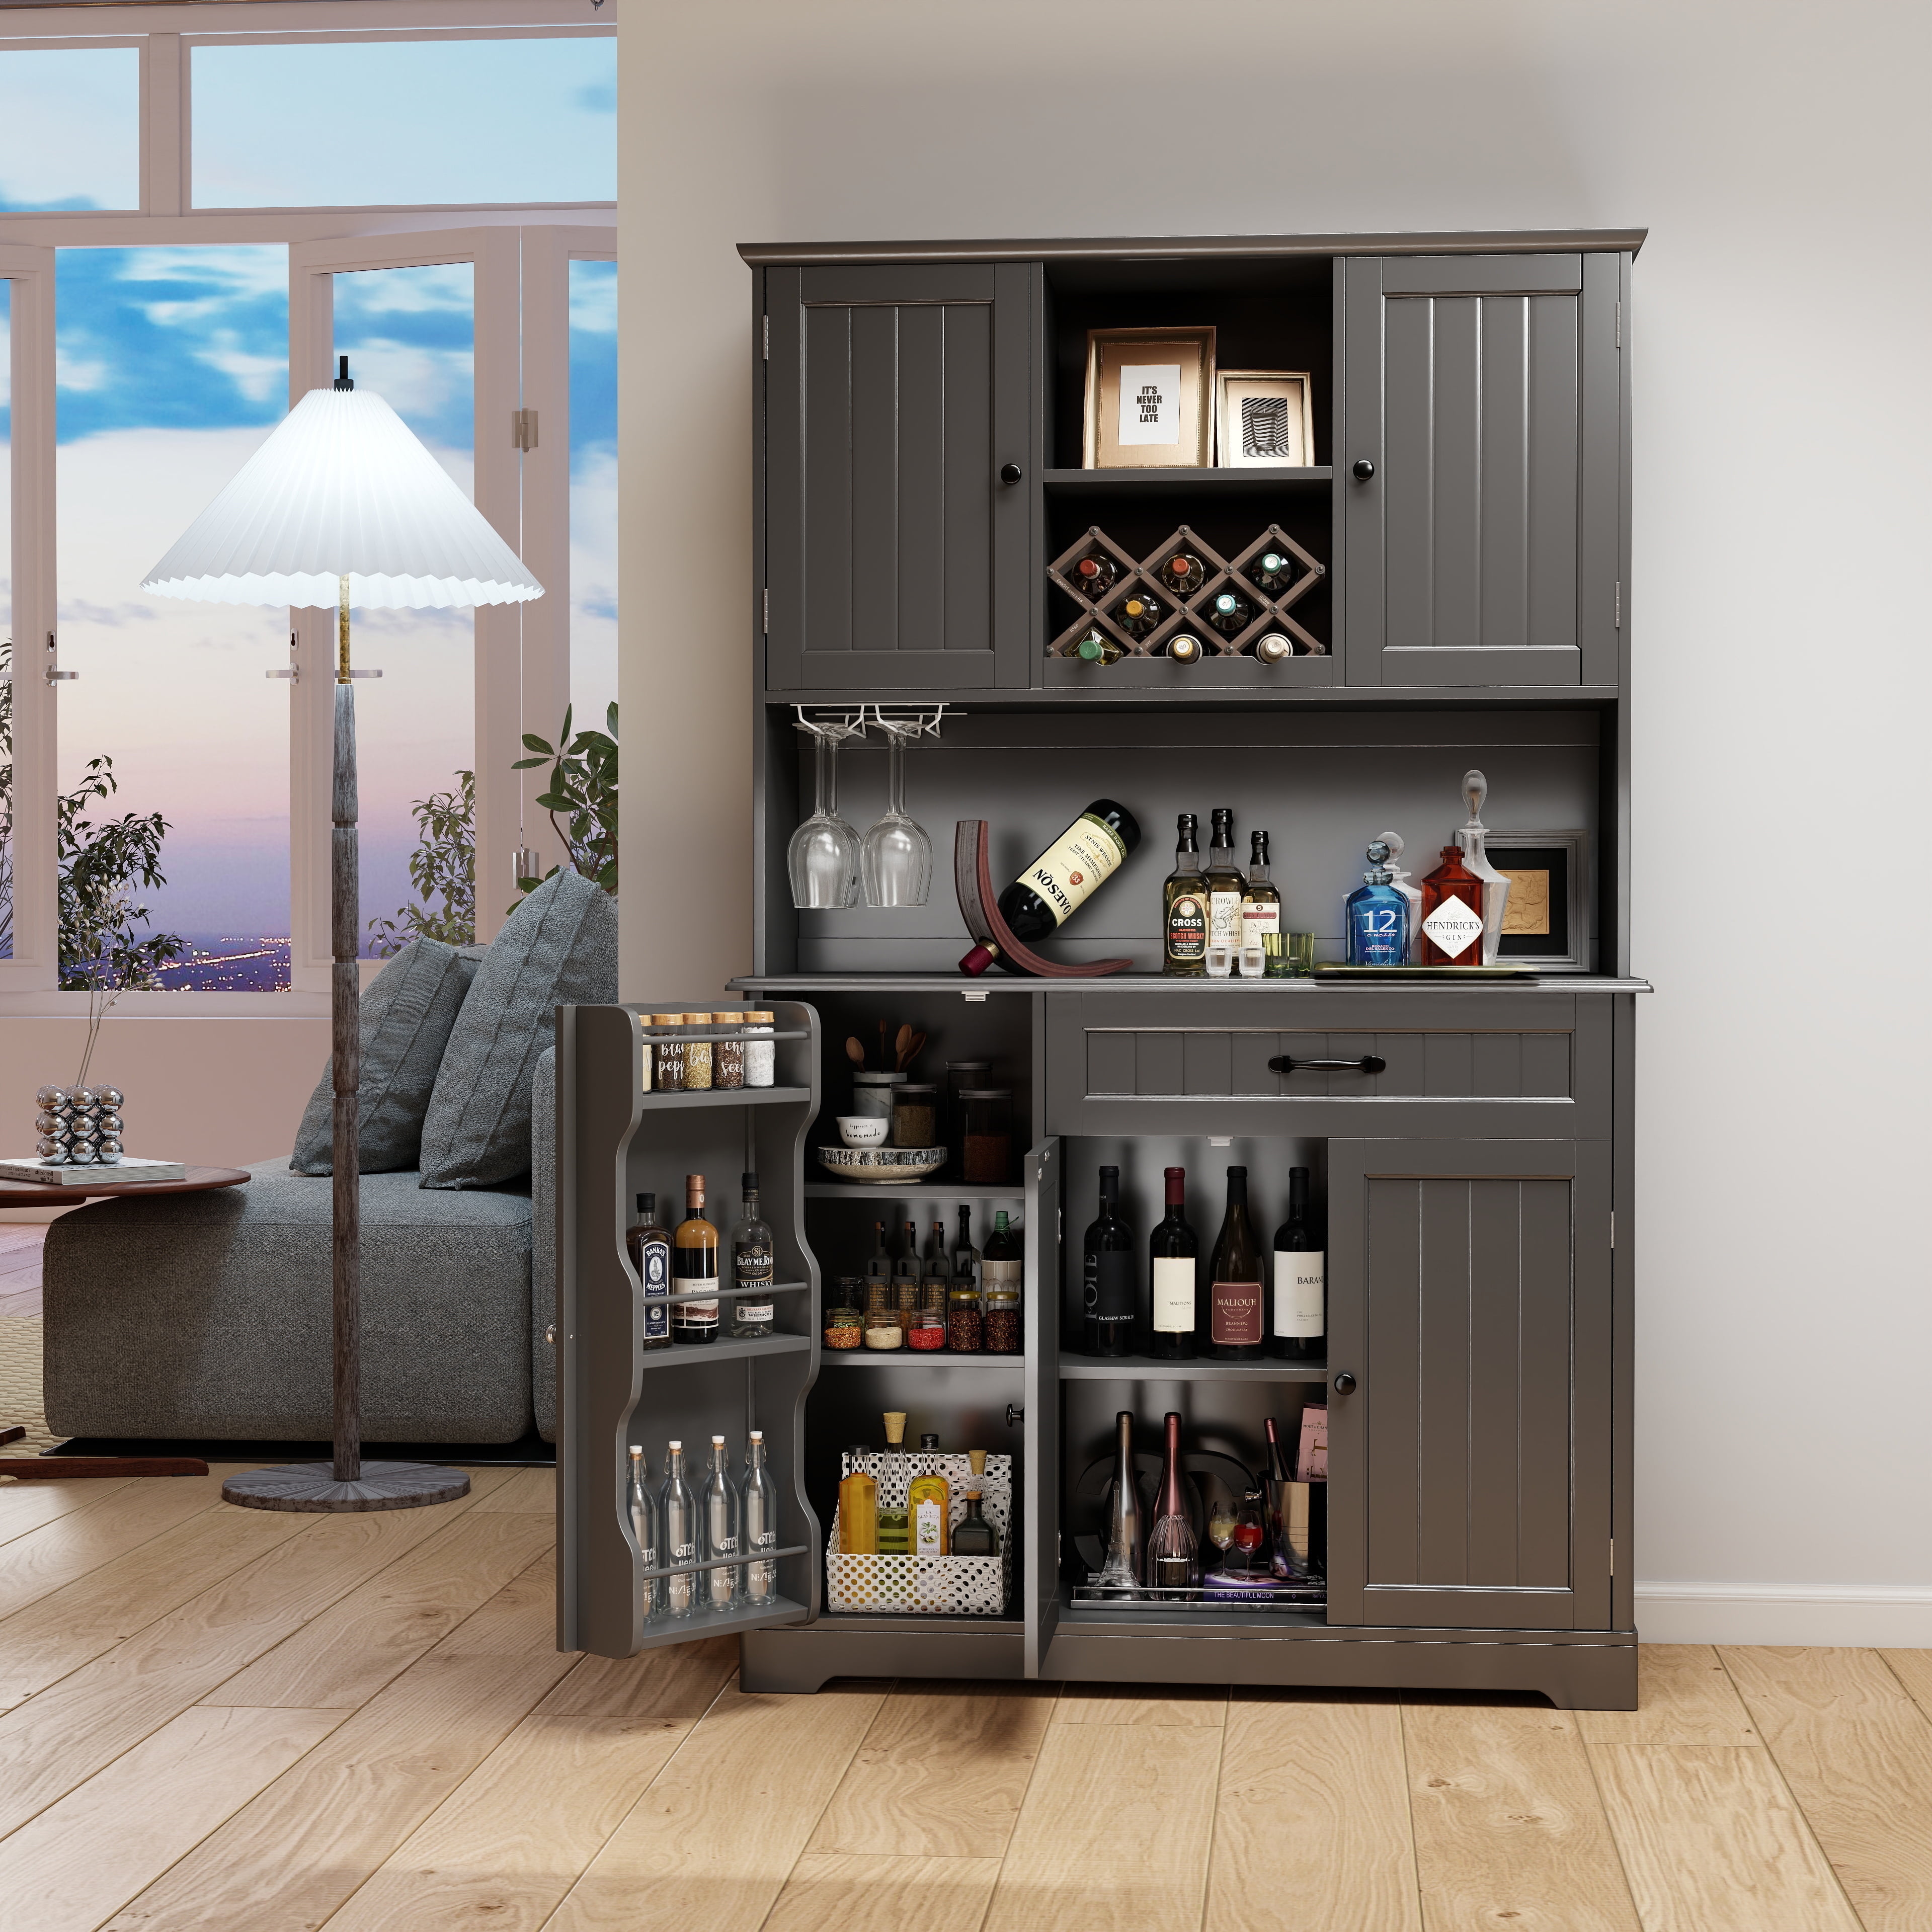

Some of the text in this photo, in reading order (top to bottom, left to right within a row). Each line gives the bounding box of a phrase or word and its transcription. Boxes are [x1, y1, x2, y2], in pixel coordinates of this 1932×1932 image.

[1142, 386, 1157, 394] IT'S
[1137, 395, 1162, 404] NEVER
[1141, 405, 1157, 413] TOO
[1140, 414, 1158, 423] LATE
[1172, 918, 1202, 927] CROSS
[1363, 910, 1397, 932] 12
[1427, 921, 1480, 930] HENDRICK'S
[846, 1128, 881, 1138] homemade
